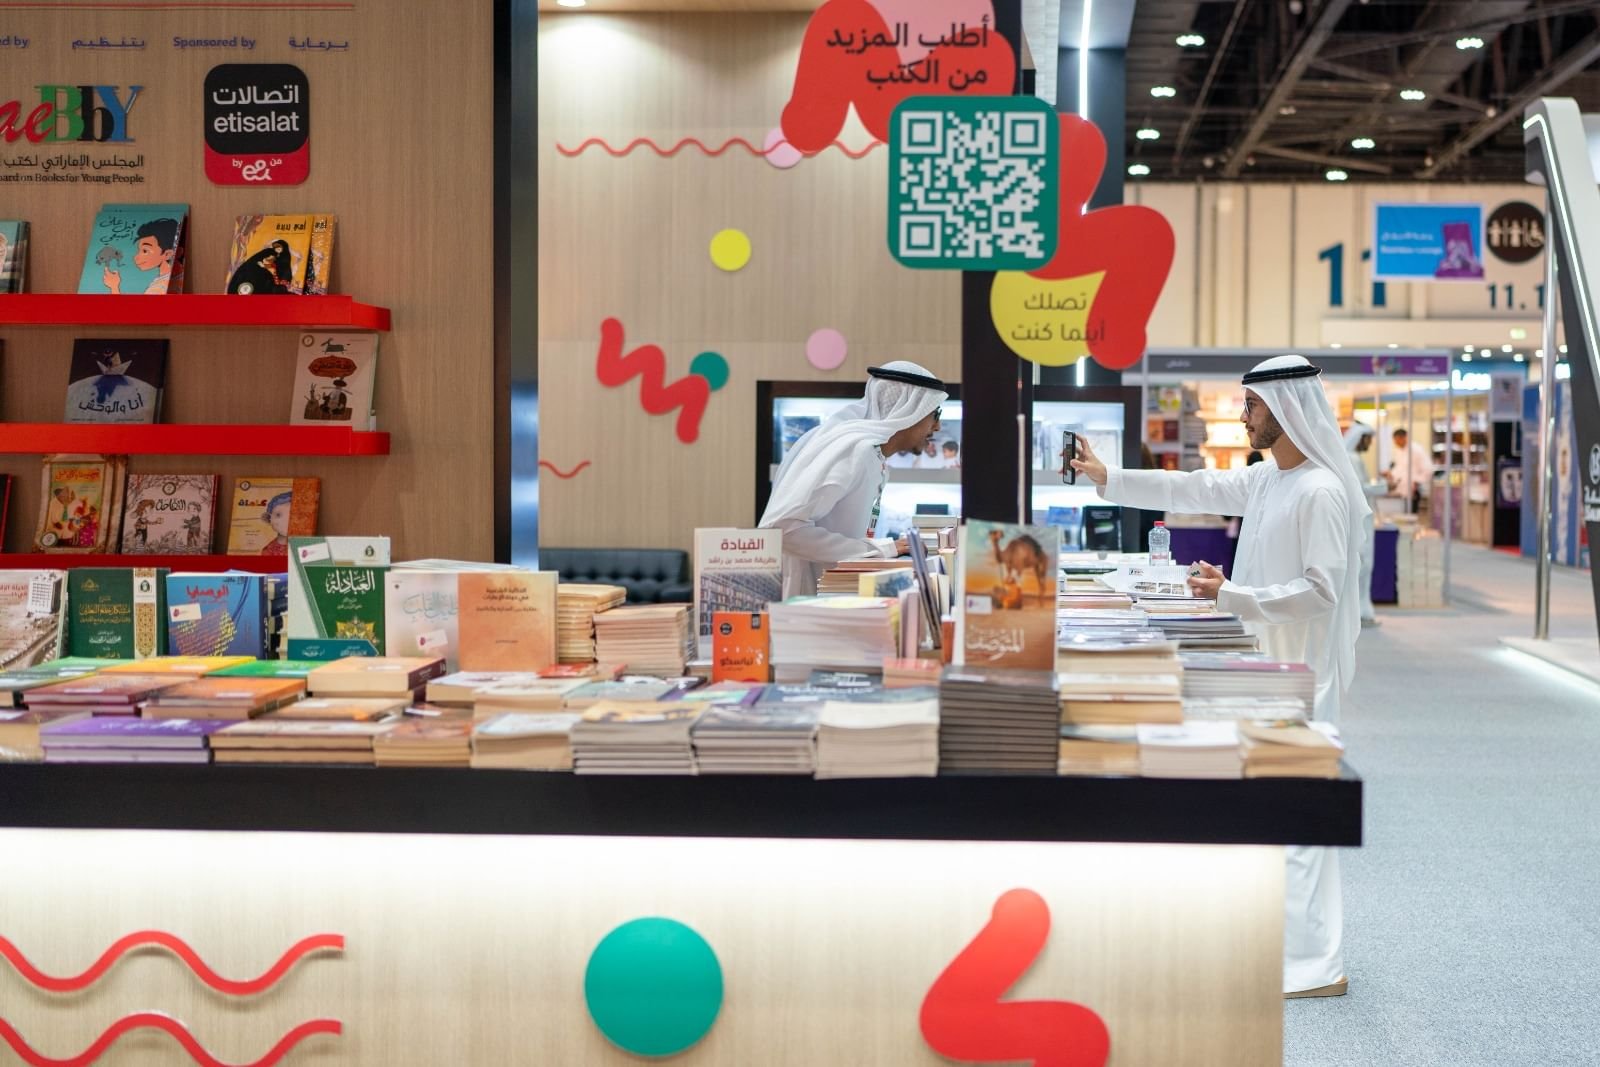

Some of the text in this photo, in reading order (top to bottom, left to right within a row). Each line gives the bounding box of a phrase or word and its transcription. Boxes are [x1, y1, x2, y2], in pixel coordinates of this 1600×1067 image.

[14, 36, 29, 48] by
[173, 36, 256, 49] Sponsored by
[288, 37, 349, 50] برعاية
[826, 15, 988, 55] أطلب المزيد
[866, 60, 988, 91] من الكتب
[212, 85, 300, 105] اتصالات
[213, 111, 300, 133] etisalat
[3, 154, 144, 172] المجلس الإماراتي لكتب
[232, 158, 243, 168] by
[35, 173, 64, 183] Books
[64, 173, 79, 183] for
[81, 173, 110, 184] Young
[112, 173, 145, 184] People
[1024, 292, 1087, 311] تصلك
[1011, 320, 1105, 345] أينما كنت
[720, 538, 764, 554] القيادة
[186, 584, 230, 600] الوصايا
